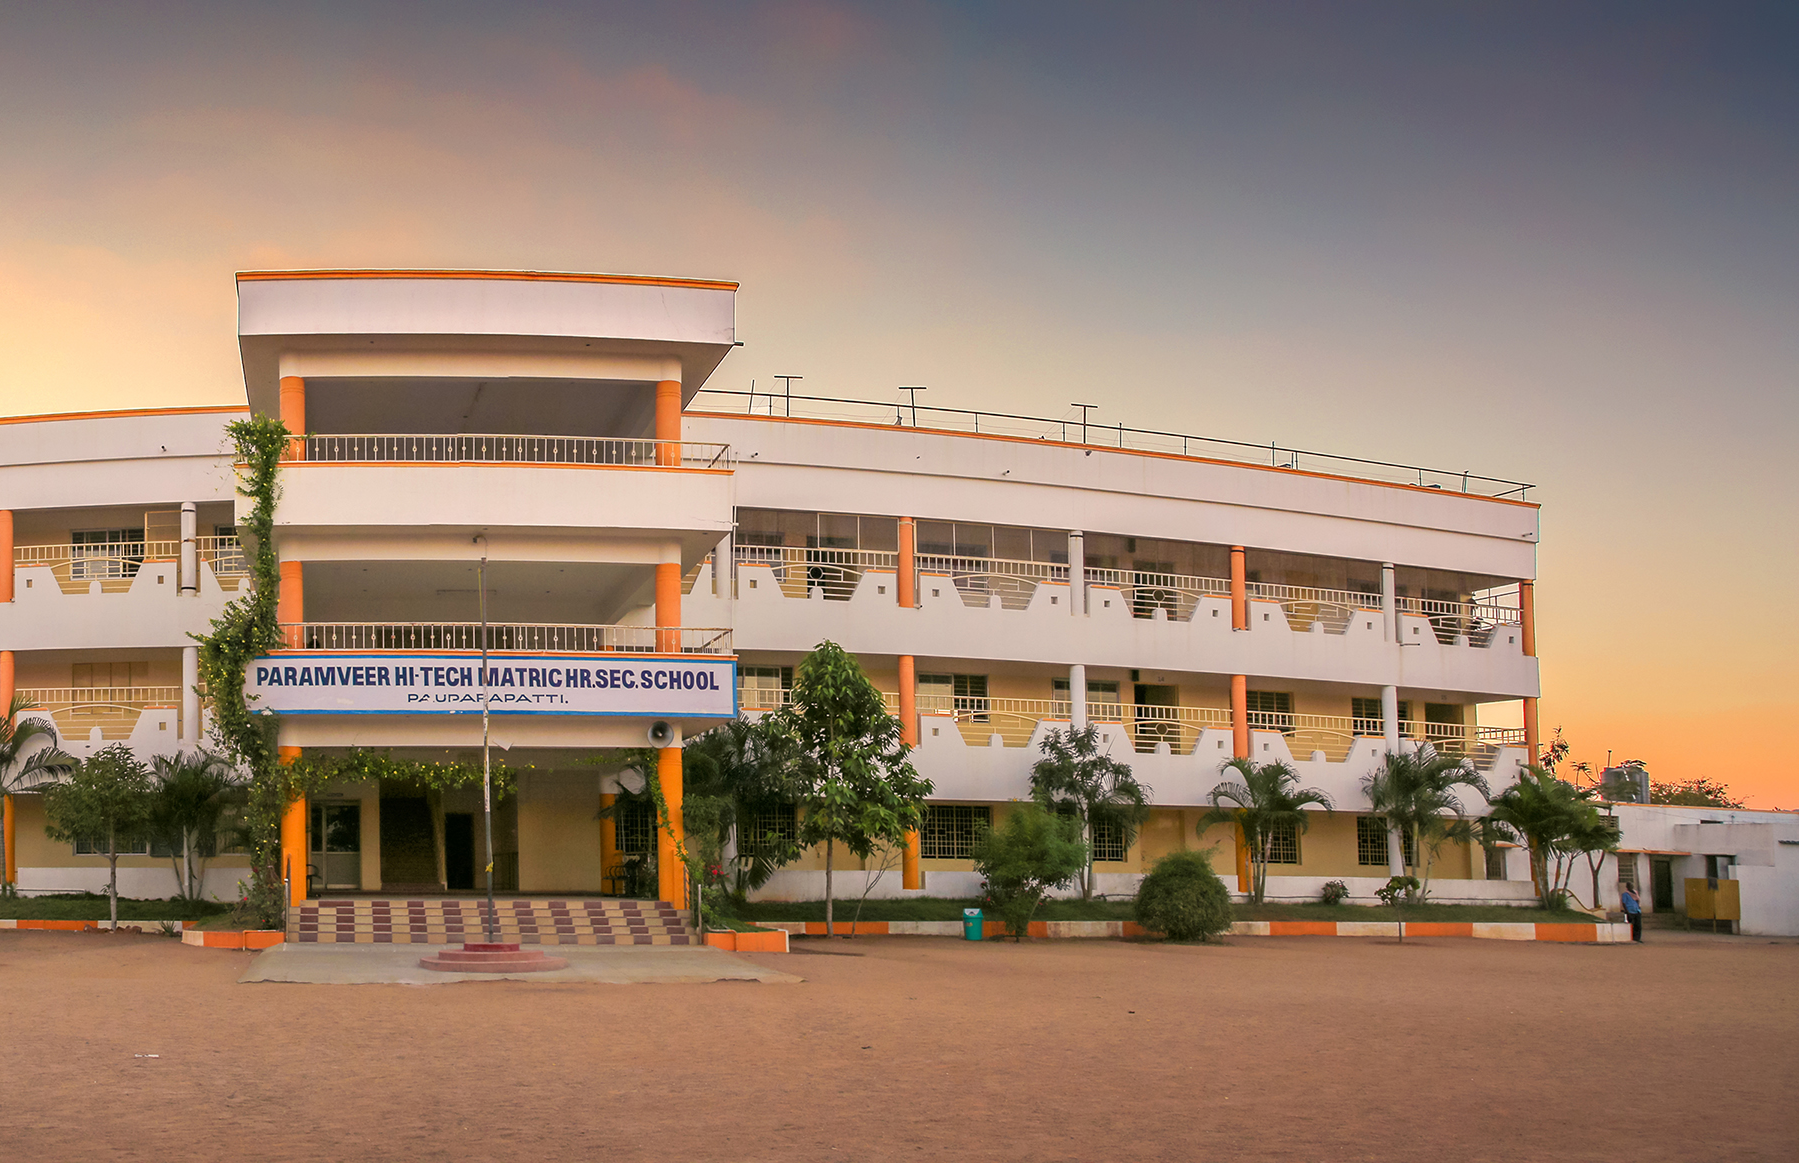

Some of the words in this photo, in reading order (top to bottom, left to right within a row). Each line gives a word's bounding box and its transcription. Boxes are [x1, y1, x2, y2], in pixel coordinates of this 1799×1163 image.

[256, 666, 391, 687] PARAMVEER
[394, 666, 473, 687] HI-TECH
[477, 667, 563, 688] MATRIC
[640, 669, 720, 691] SCHOOL
